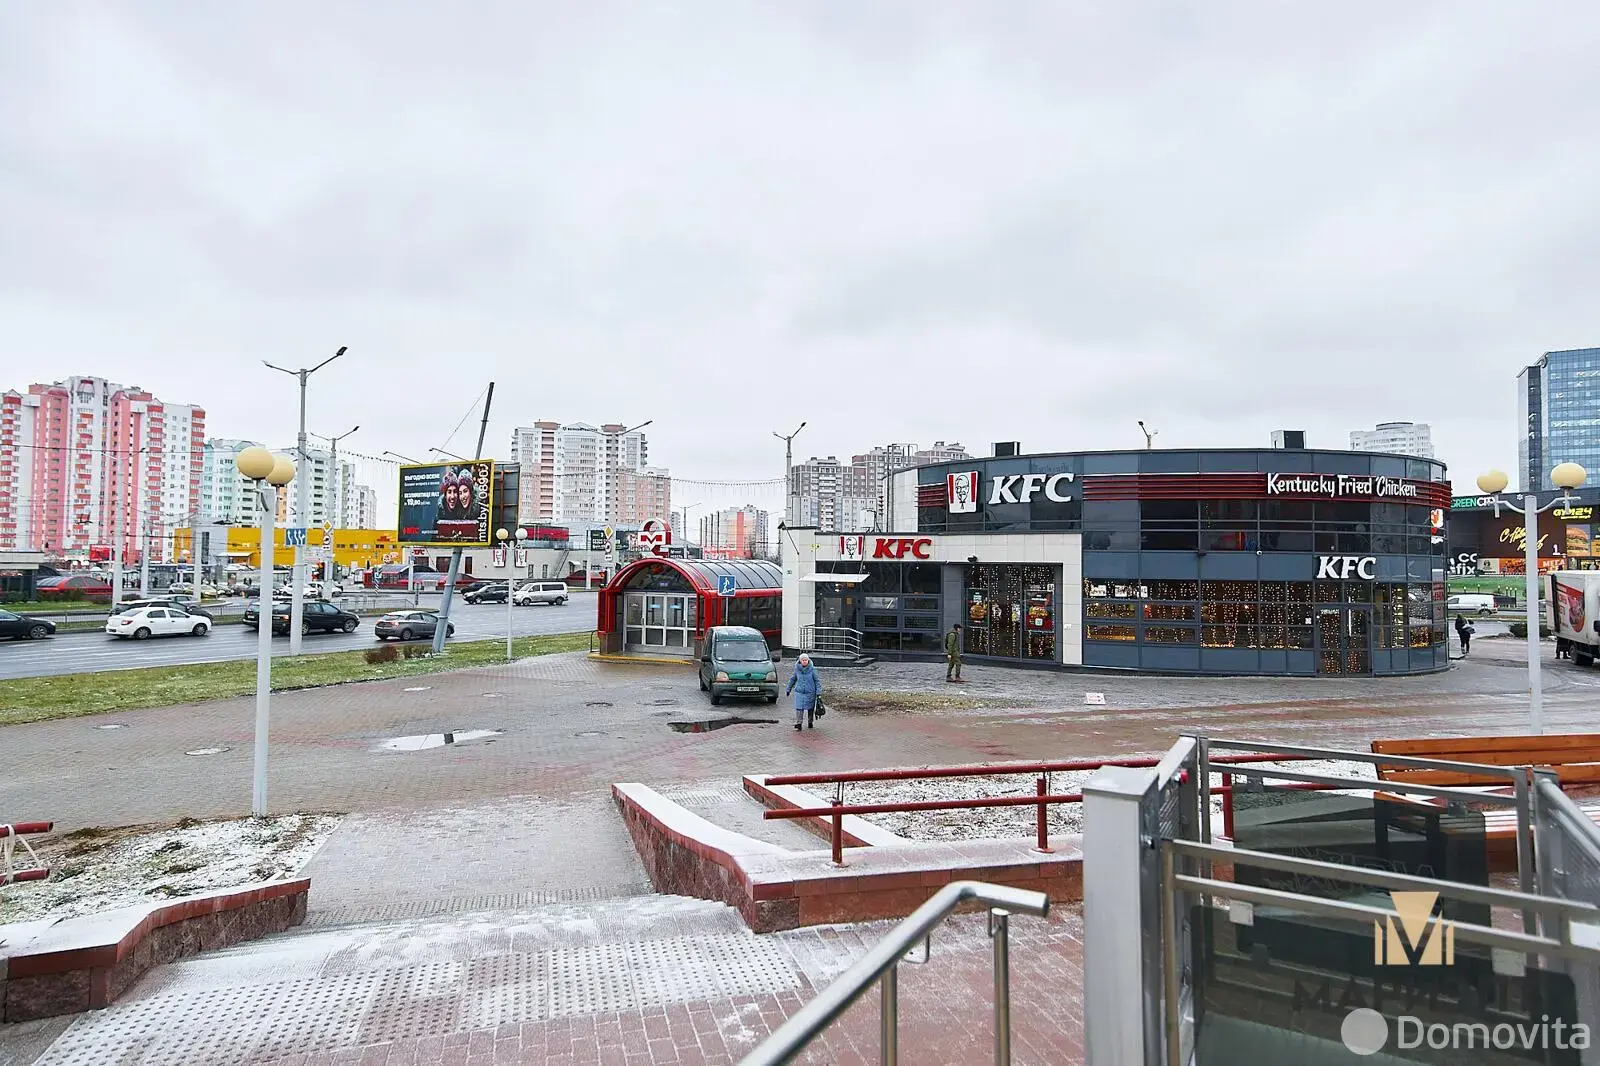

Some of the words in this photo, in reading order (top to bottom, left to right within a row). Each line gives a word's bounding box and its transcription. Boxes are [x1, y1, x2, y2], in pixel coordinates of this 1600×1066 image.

[988, 473, 1075, 505] KFC
[1267, 472, 1335, 498] Kentucky
[1337, 474, 1372, 496] Fried
[1375, 475, 1417, 497] Chicken
[872, 538, 932, 559] KFC
[1316, 556, 1377, 580] KFC
